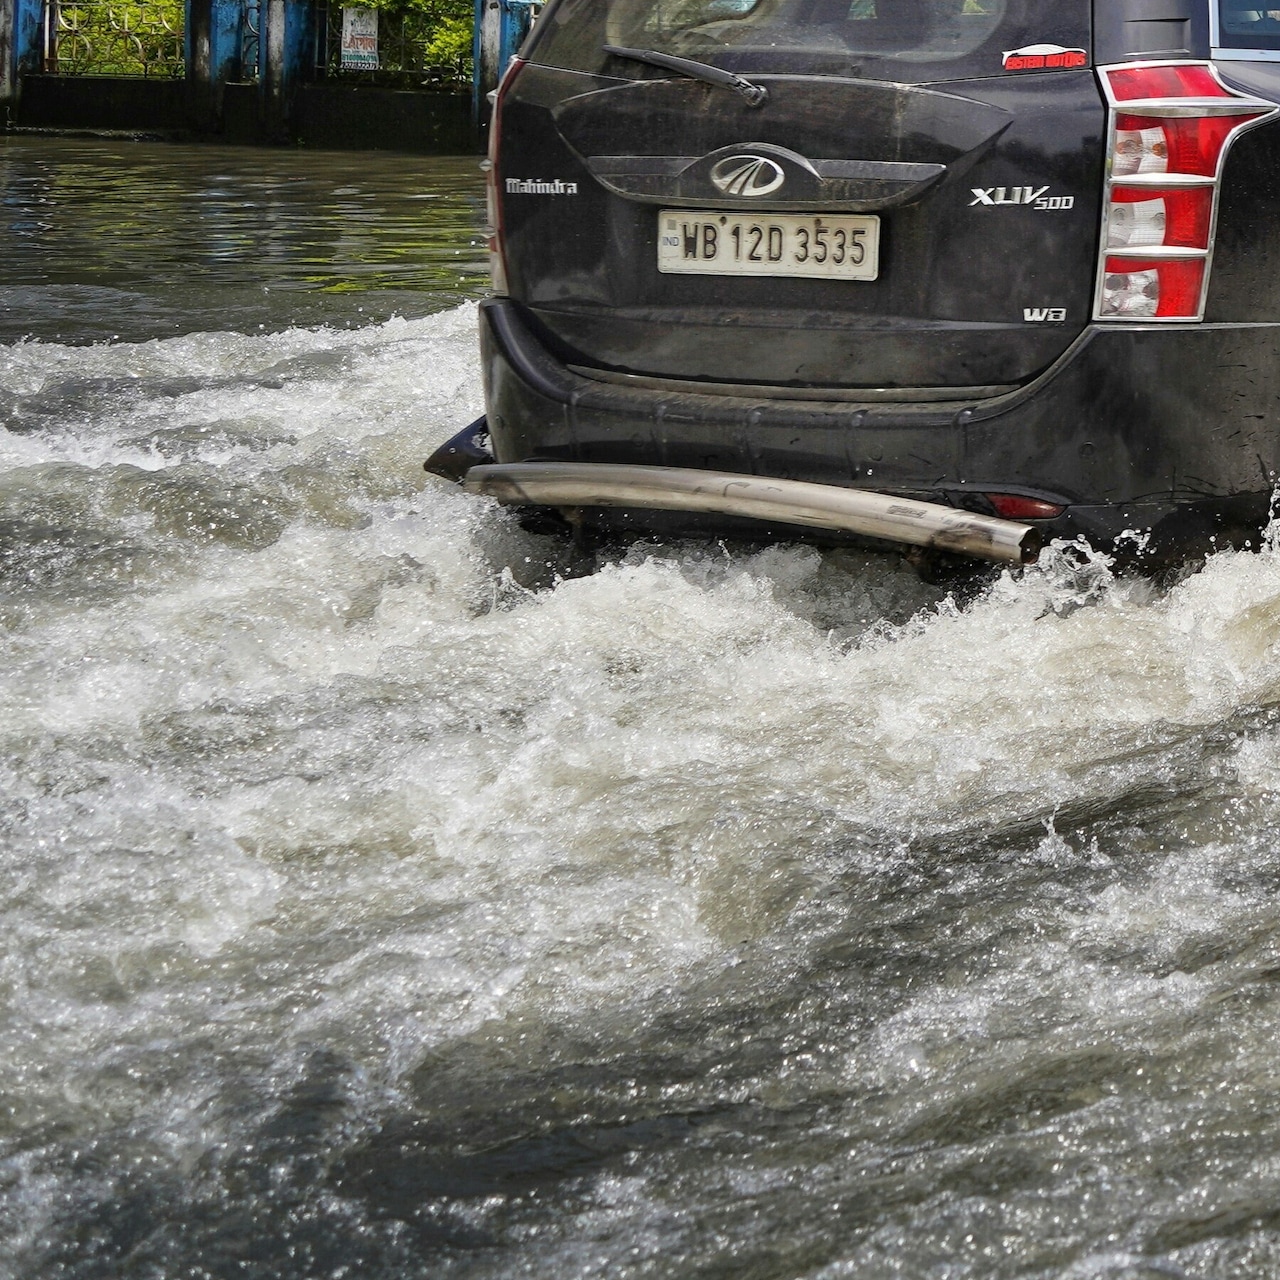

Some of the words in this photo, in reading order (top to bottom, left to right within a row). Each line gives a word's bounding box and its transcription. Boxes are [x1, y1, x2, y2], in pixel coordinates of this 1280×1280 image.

[1045, 51, 1086, 69] MOTORS
[505, 178, 578, 195] Mahindra
[662, 236, 680, 247] IND
[682, 223, 718, 261] WB
[795, 228, 867, 266] 3535
